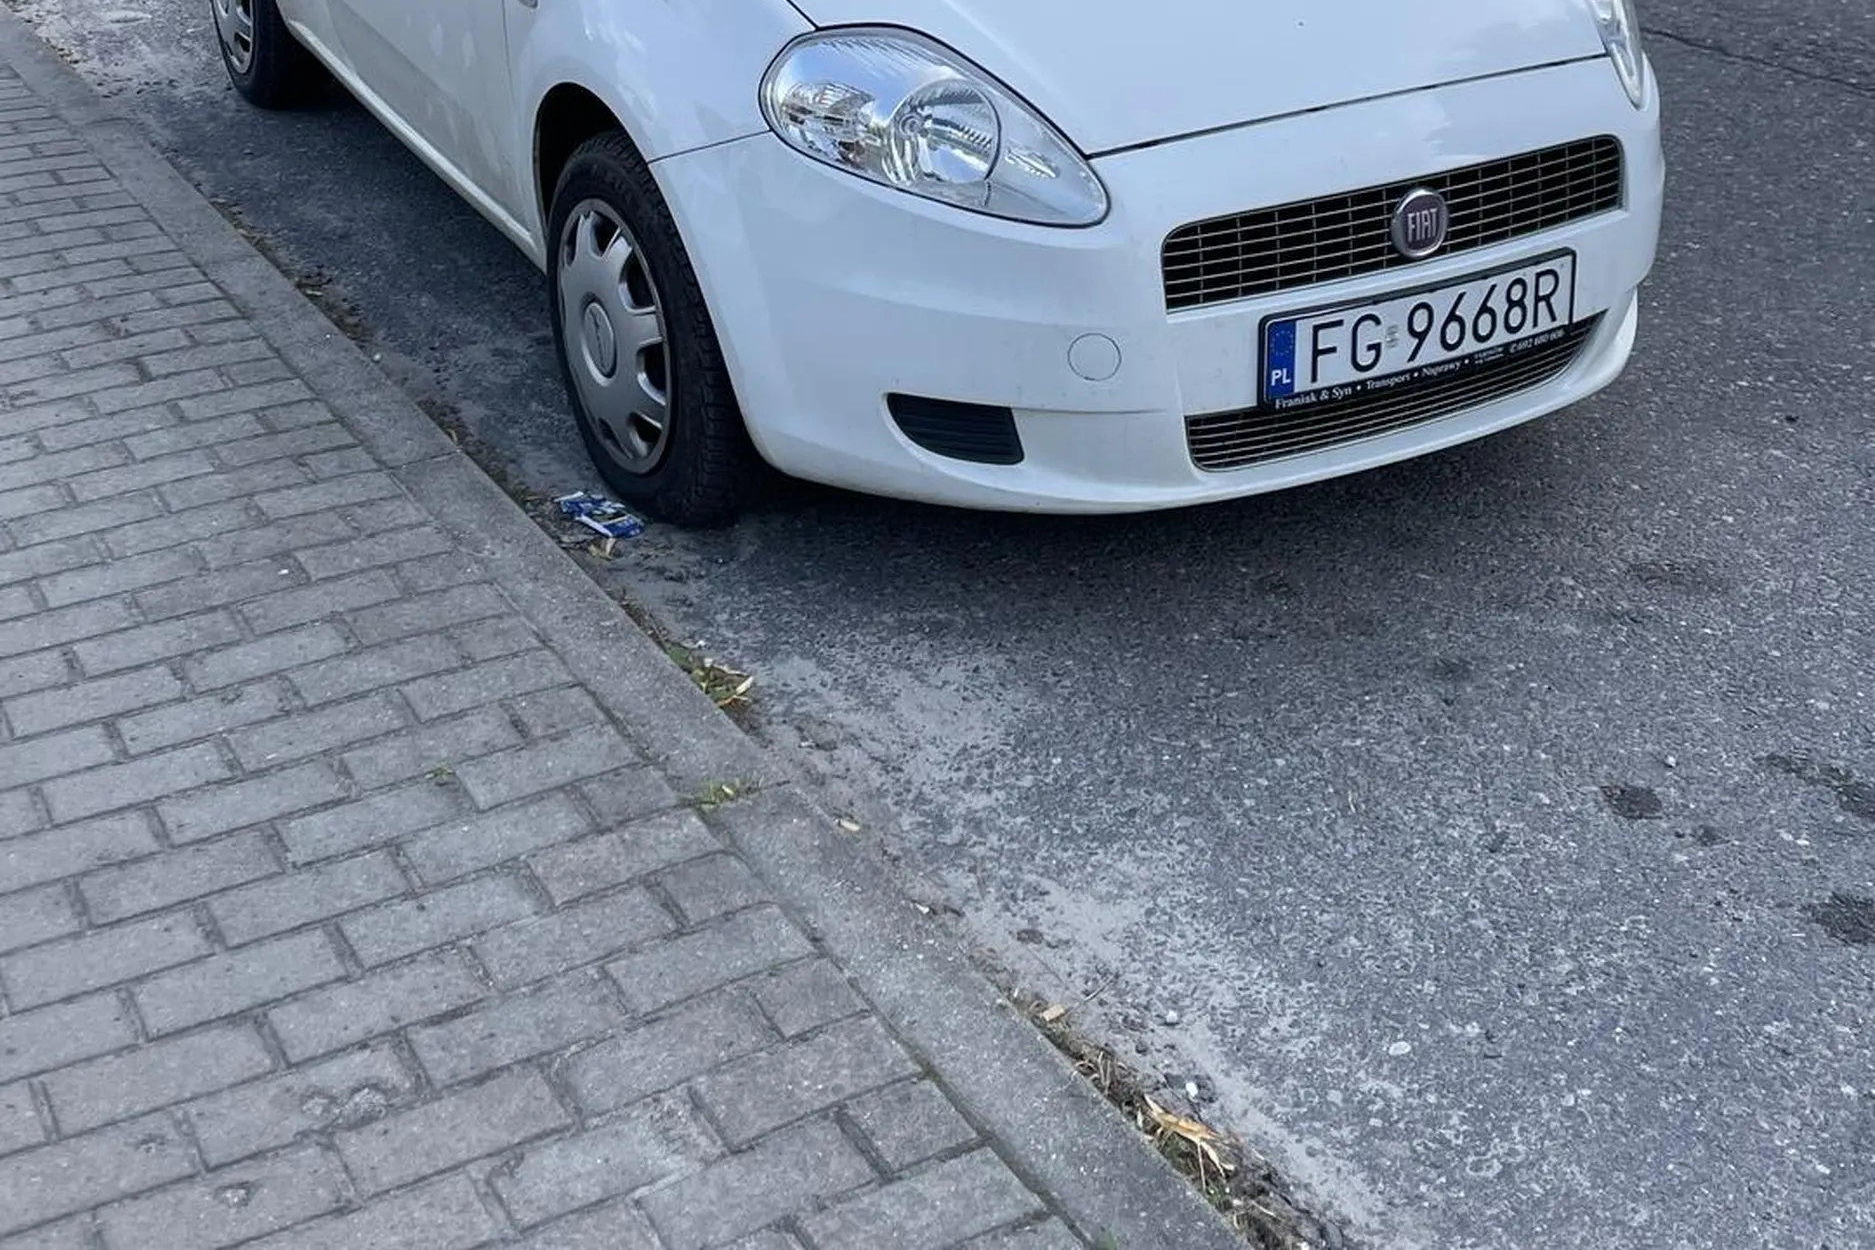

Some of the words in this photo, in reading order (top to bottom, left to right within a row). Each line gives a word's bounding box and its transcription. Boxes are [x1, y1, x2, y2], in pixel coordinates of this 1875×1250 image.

[1407, 208, 1437, 242] FIAT
[1310, 313, 1382, 383] FG
[1406, 268, 1560, 363] 9668R
[1271, 368, 1291, 386] PL
[1320, 389, 1330, 401] &
[1331, 386, 1353, 401] Syn
[1366, 372, 1411, 390] Transport
